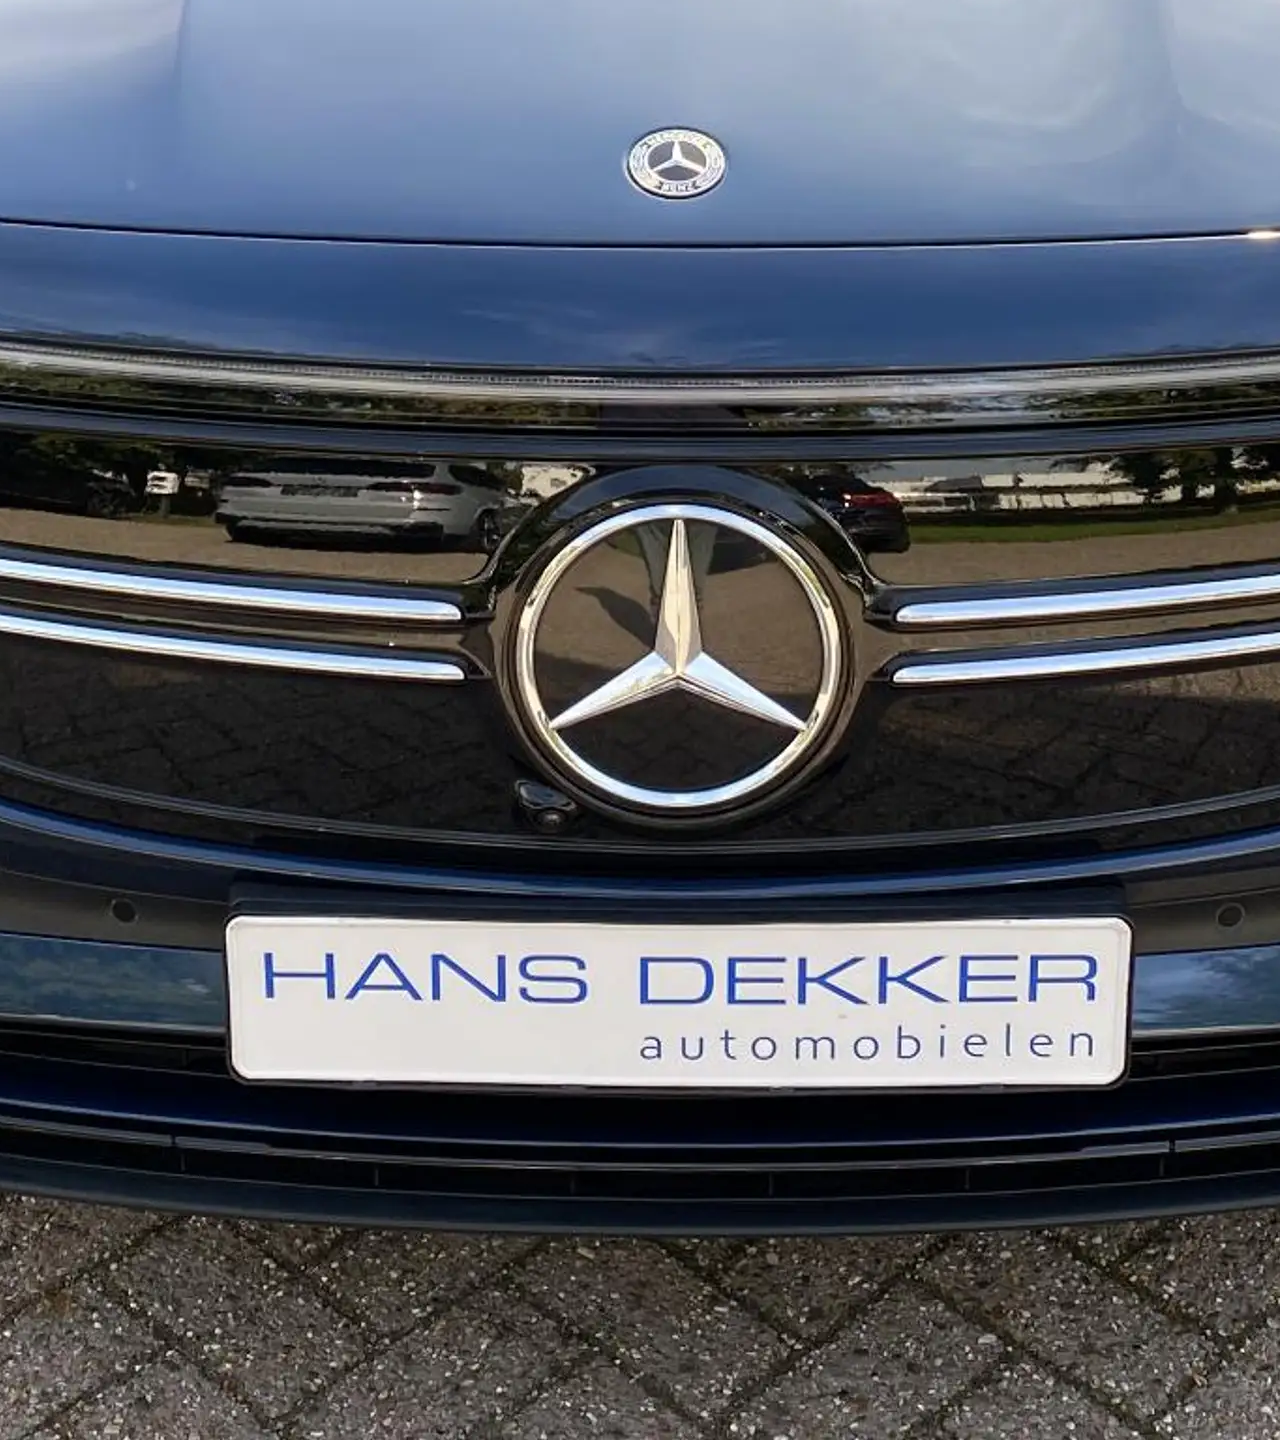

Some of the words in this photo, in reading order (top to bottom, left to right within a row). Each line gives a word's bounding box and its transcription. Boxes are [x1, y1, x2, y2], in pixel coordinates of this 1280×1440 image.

[262, 951, 589, 1005] HANS
[638, 954, 1099, 1007] DEKKER
[638, 1023, 1095, 1062] automobielen
